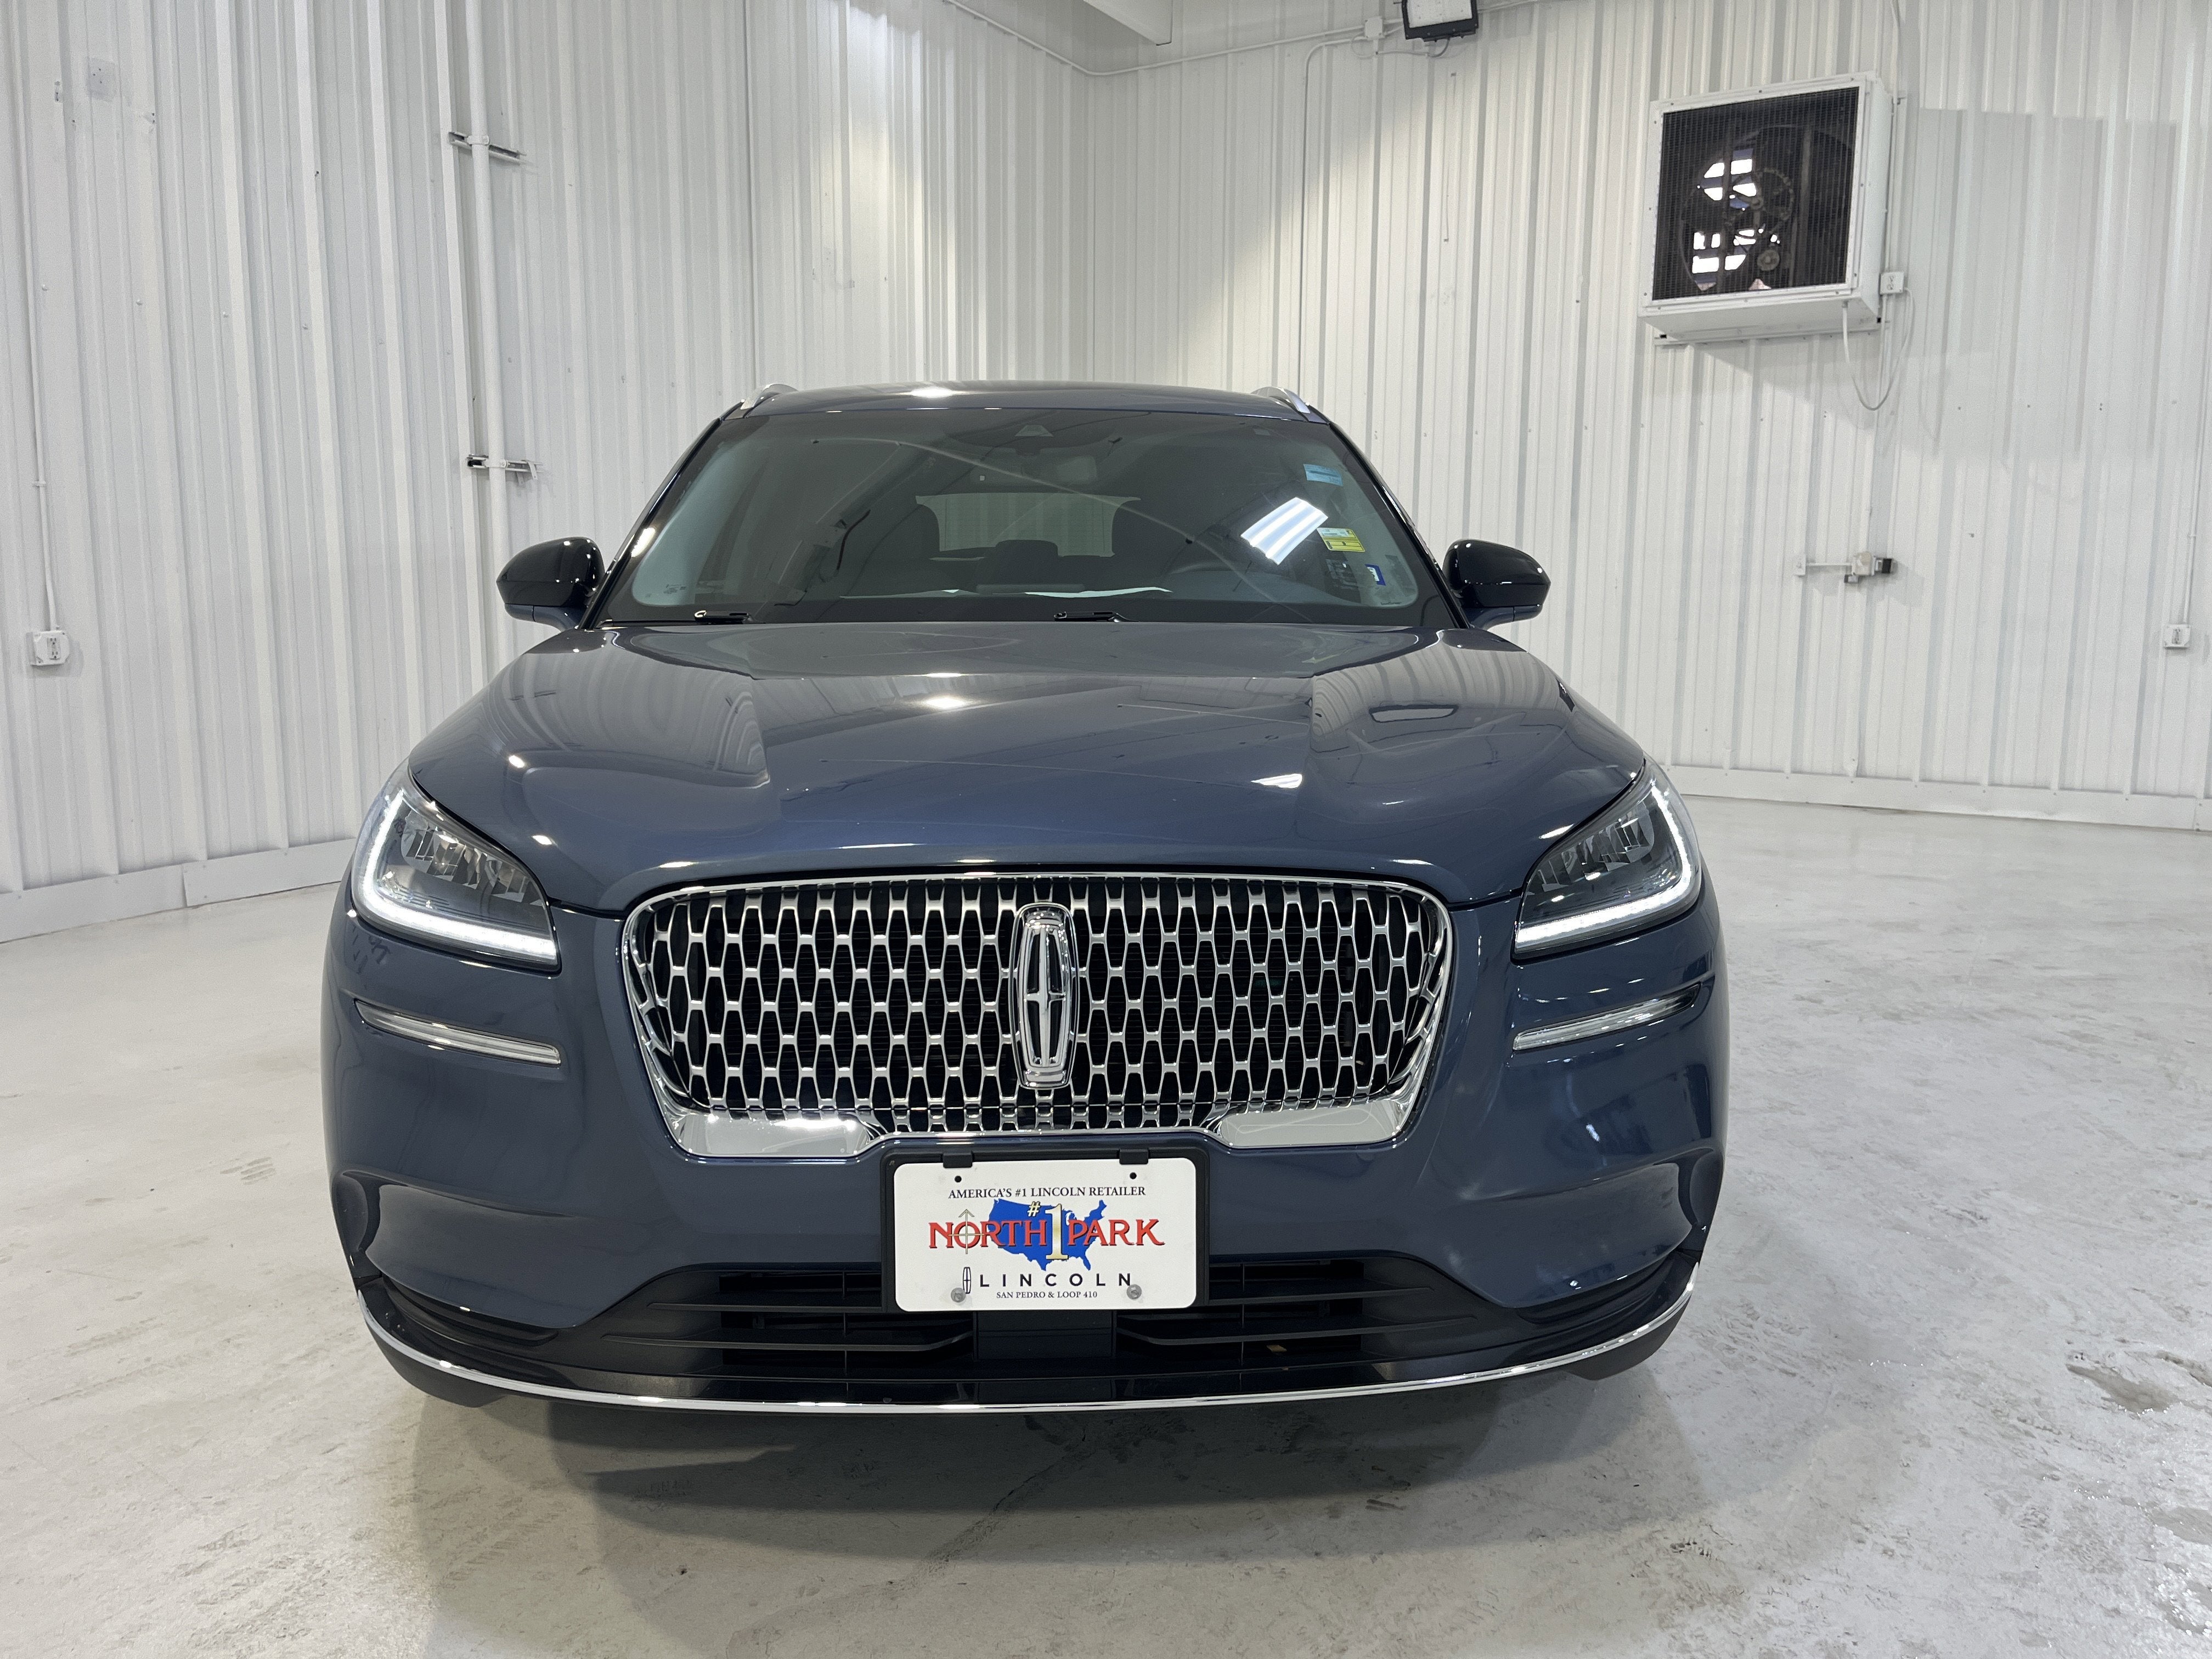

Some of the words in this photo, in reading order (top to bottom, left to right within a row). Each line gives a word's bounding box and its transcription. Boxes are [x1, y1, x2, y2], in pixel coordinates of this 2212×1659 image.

[948, 1188, 1012, 1199] AMERICA'S
[1015, 1188, 1027, 1197] #1
[1031, 1187, 1086, 1197] LINCOLN
[1089, 1186, 1147, 1196] RETAILER
[929, 1220, 1047, 1249] NORTH
[1068, 1219, 1165, 1246] PARK
[980, 1273, 1131, 1288] LINCOLN
